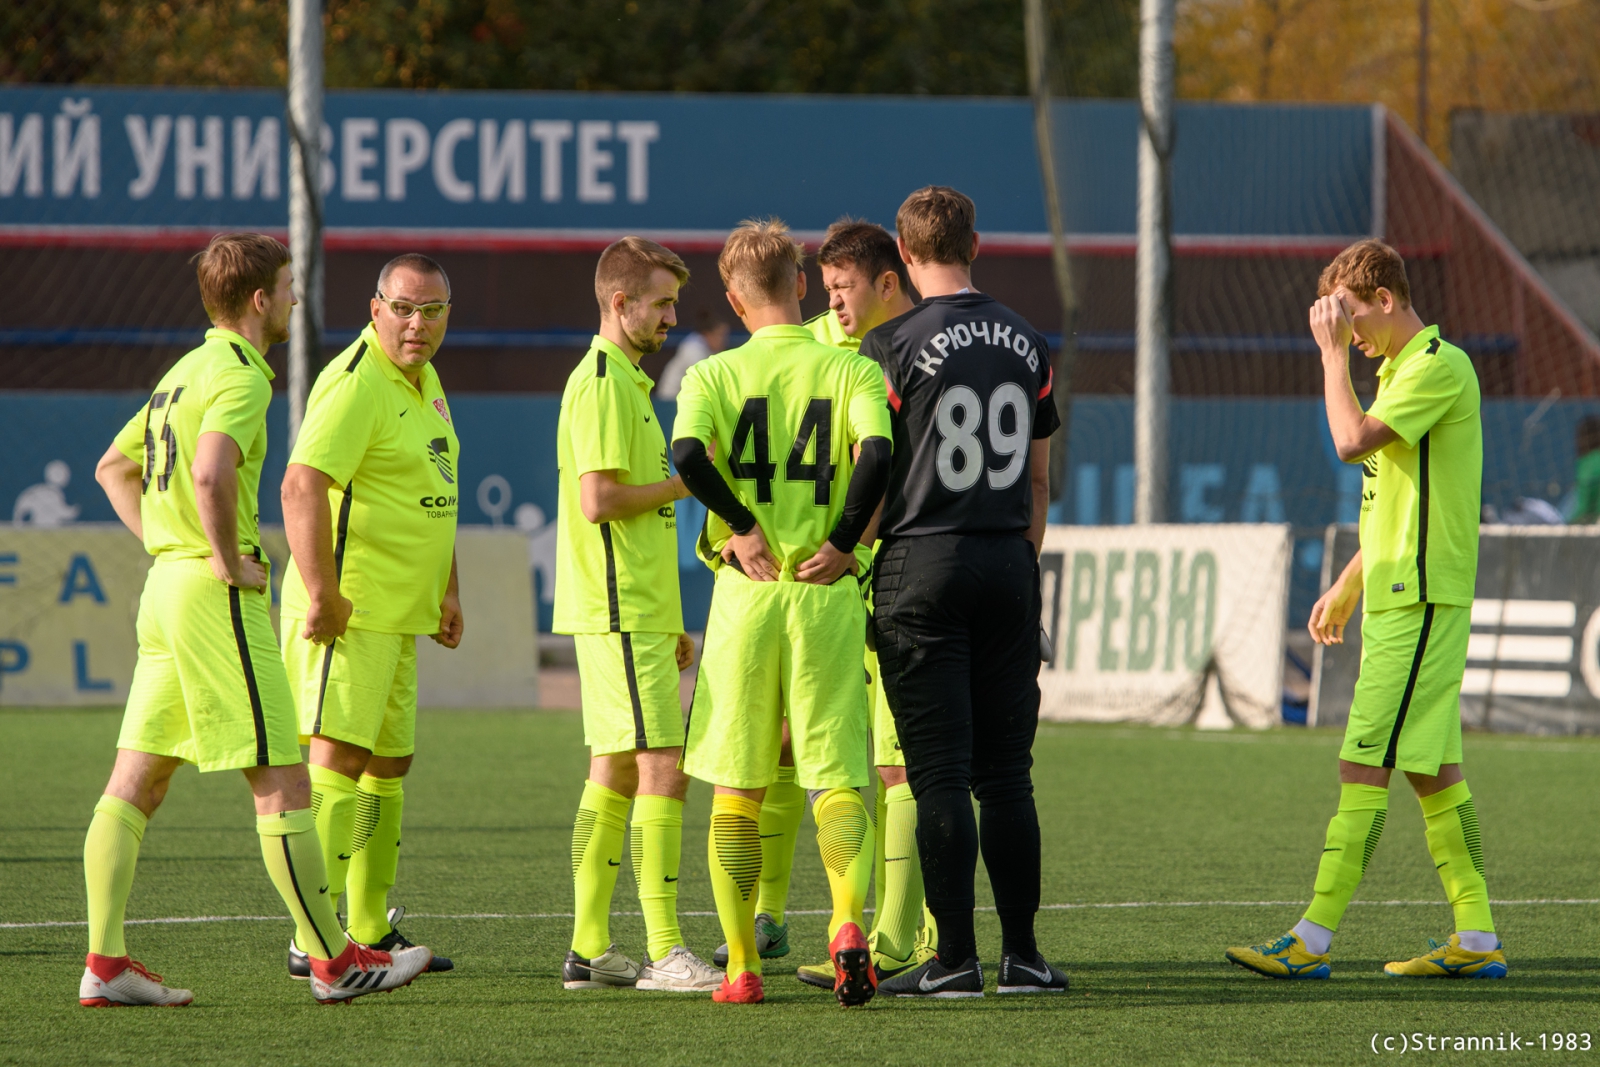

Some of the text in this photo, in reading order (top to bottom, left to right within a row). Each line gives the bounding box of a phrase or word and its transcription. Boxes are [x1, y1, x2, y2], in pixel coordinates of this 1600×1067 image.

[914, 321, 1040, 377] КРЮЧКОВ
[727, 395, 838, 507] 44
[935, 381, 1031, 492] 89
